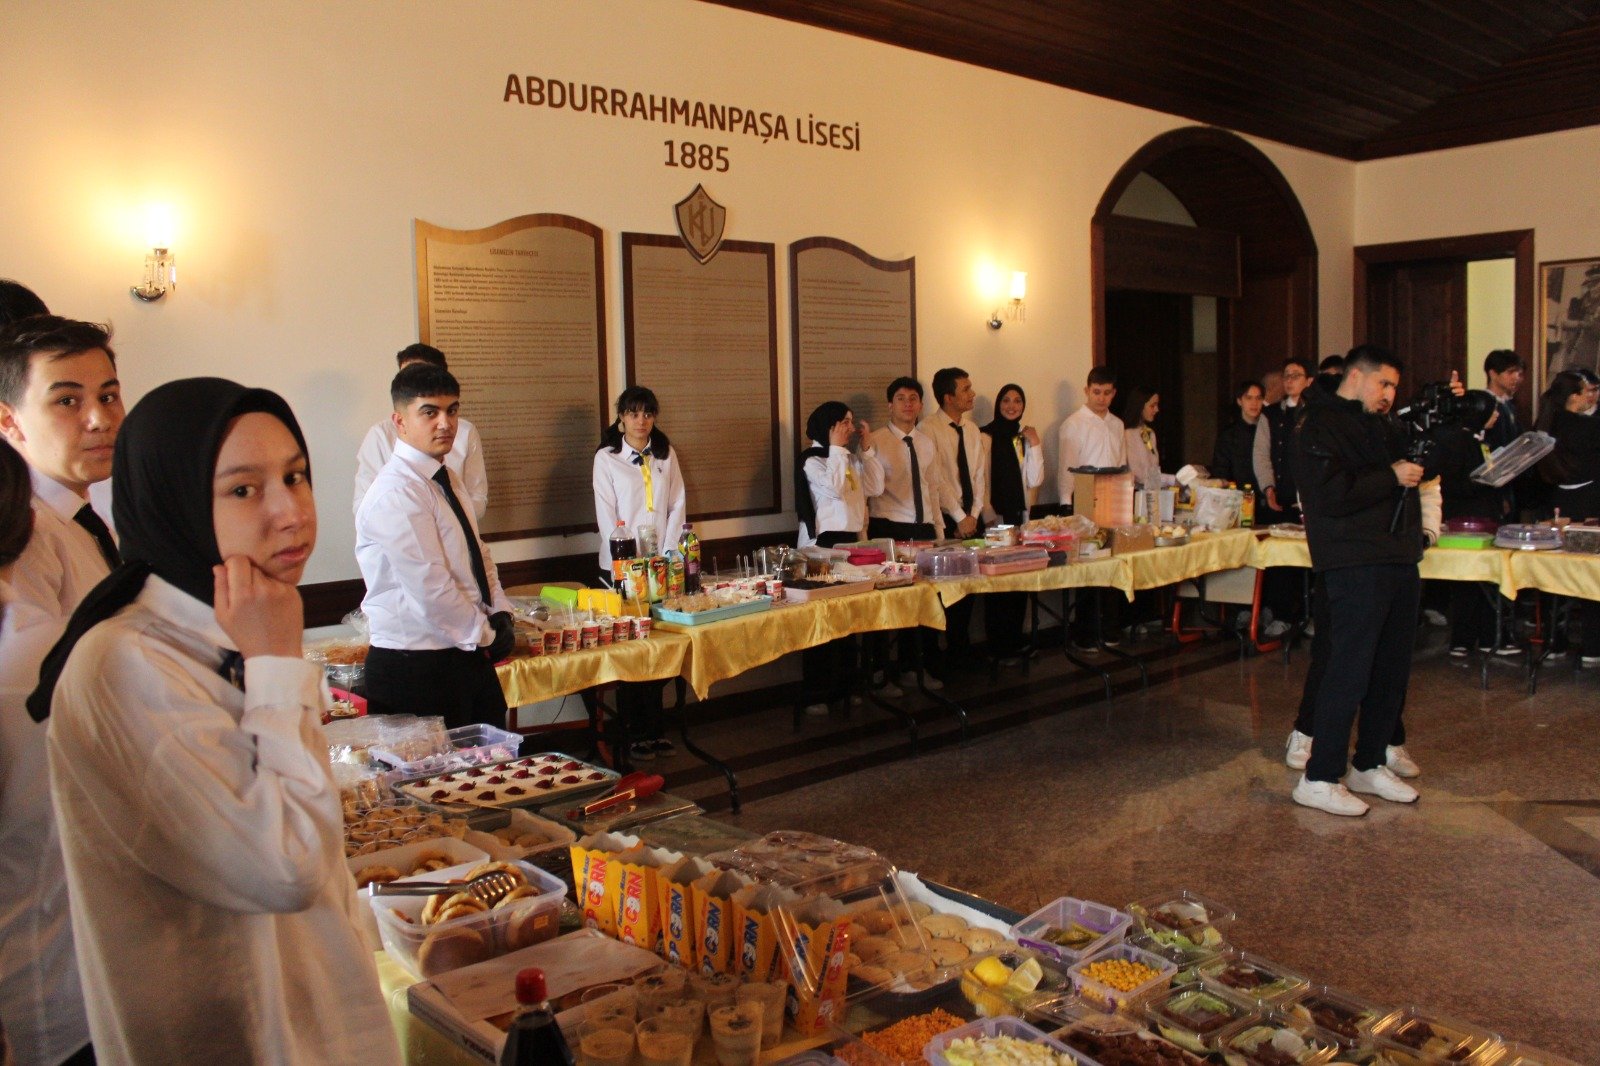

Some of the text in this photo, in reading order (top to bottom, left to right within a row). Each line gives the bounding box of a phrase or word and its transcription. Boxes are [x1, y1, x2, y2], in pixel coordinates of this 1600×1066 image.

[503, 73, 861, 152] ABDURRAHMANPAŞA LİSESİ
[664, 140, 730, 173] 1885
[588, 857, 608, 907] CORN
[625, 871, 643, 924] CORN
